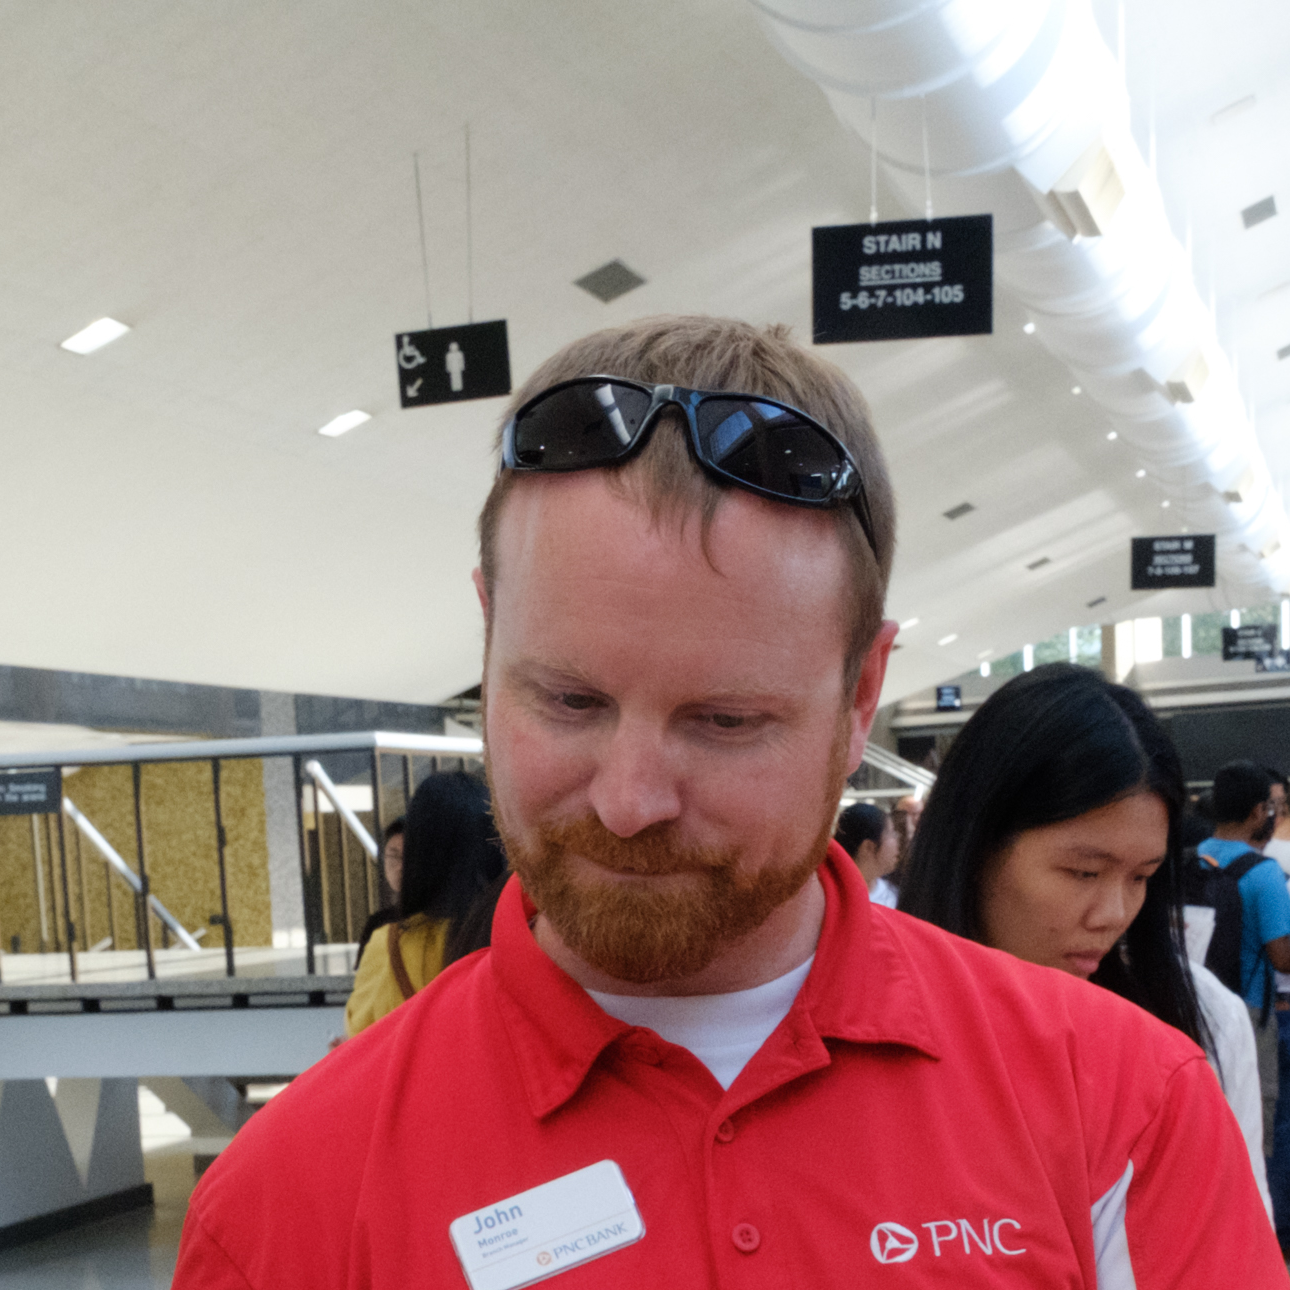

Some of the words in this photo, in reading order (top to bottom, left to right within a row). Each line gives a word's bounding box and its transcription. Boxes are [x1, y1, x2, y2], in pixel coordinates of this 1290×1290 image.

[862, 232, 922, 255] STAIR
[926, 231, 943, 250] N
[859, 261, 942, 283] SECTIONS
[839, 284, 965, 311] 5-6-7-104-105
[474, 1205, 523, 1234] John
[478, 1228, 518, 1248] Monroe
[920, 1218, 1027, 1257] PNC
